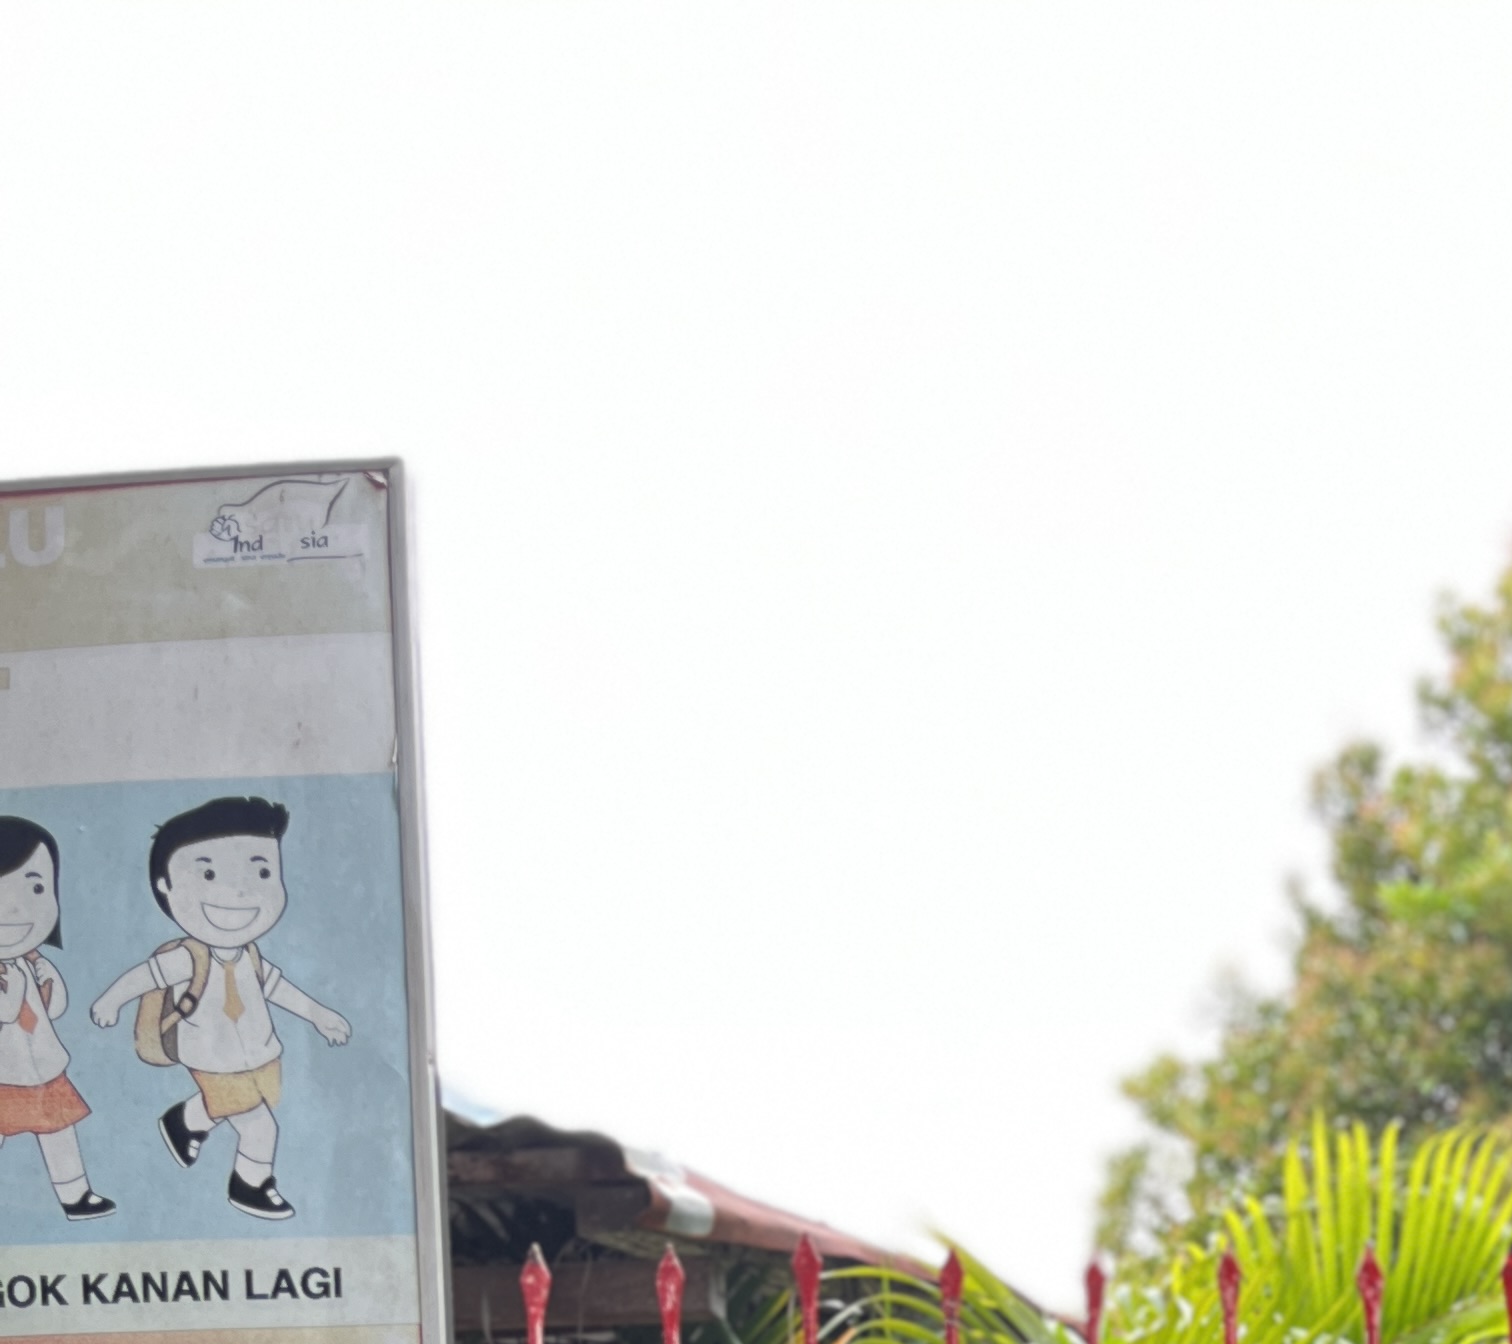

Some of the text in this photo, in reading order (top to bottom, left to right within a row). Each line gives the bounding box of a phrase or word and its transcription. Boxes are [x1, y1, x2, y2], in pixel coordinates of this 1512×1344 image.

[0, 506, 65, 568] U
[0, 1266, 344, 1309] OK KANAN LAGI
